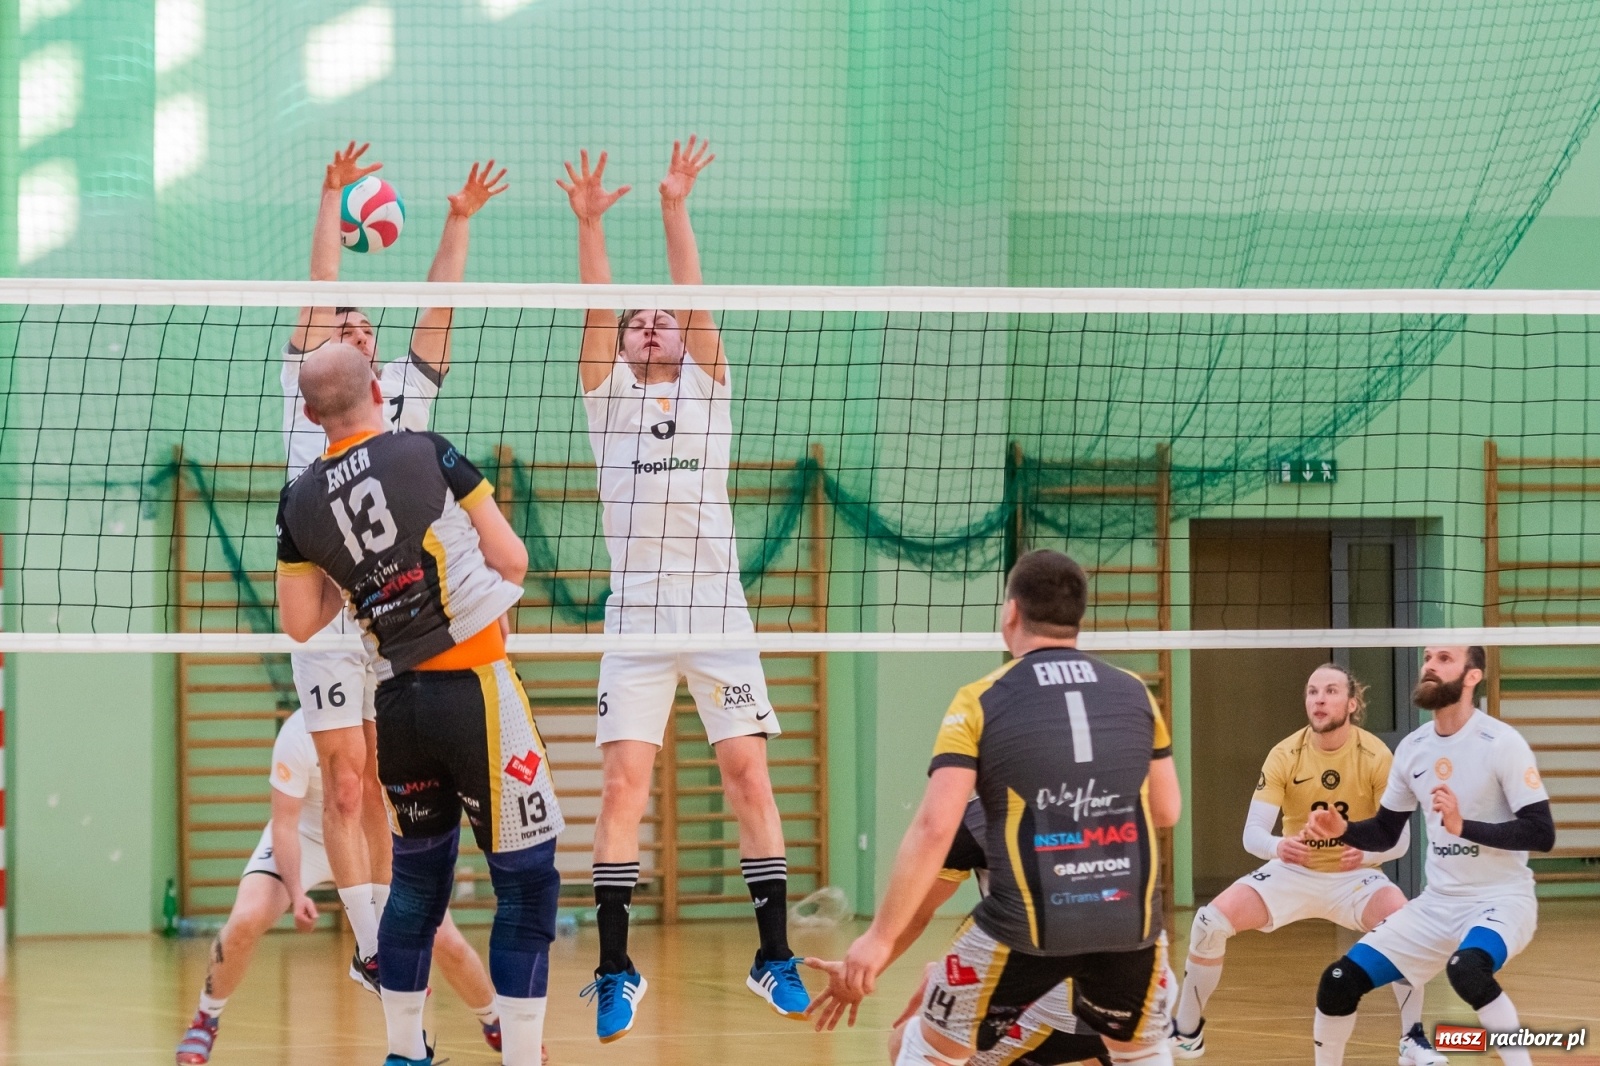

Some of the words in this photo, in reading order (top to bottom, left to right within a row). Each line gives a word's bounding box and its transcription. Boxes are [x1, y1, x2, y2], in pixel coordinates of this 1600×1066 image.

[325, 447, 371, 494] ENTER
[631, 457, 699, 475] TropiDog
[329, 476, 398, 565] 13
[1032, 660, 1098, 686] ENTER
[310, 682, 346, 710] 16
[722, 683, 751, 697] ZOO
[724, 693, 755, 707] MAR
[1064, 691, 1093, 763] 1
[518, 791, 547, 827] 13
[1069, 778, 1121, 822] Hair
[1034, 822, 1138, 848] INSTALMAG
[1053, 857, 1131, 876] GRAVTON
[927, 985, 957, 1020] 14
